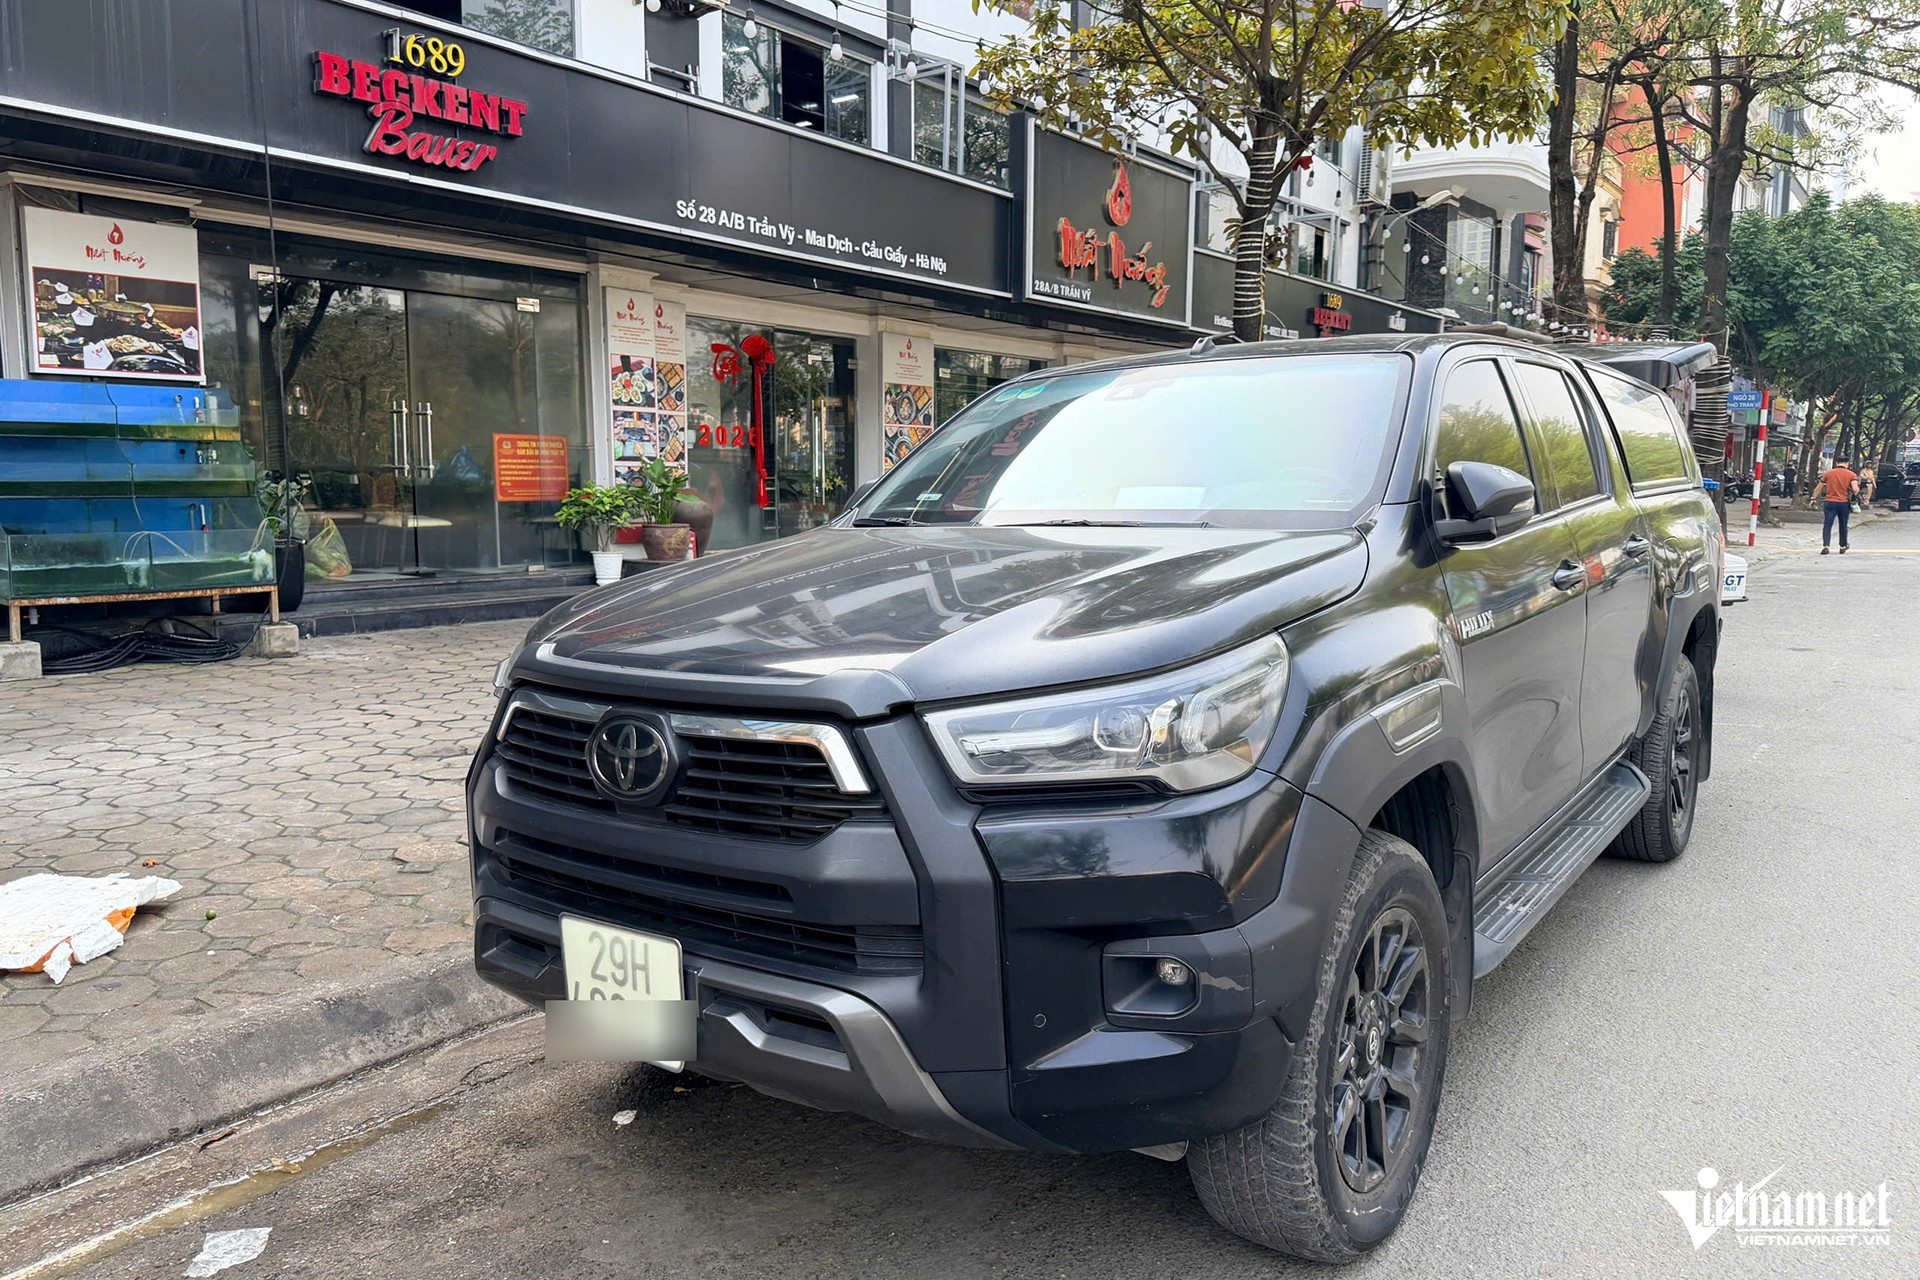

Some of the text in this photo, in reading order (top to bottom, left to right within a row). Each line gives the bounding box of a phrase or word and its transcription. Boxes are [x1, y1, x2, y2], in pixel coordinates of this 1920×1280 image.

[383, 27, 465, 77] 1689
[312, 51, 528, 137] BECKENT
[363, 101, 498, 171] Bauer
[676, 199, 696, 220] Số
[699, 205, 716, 224] 28
[718, 210, 745, 231] A/B
[778, 223, 796, 245] Vỹ
[805, 229, 826, 248] Mai
[828, 233, 853, 254] Dịch
[884, 246, 908, 268] Giấy
[916, 252, 930, 270] Hà
[930, 256, 947, 275] Nội
[1034, 279, 1059, 295] 28A/B
[1460, 609, 1495, 639] HILUX
[588, 930, 652, 995] 29H
